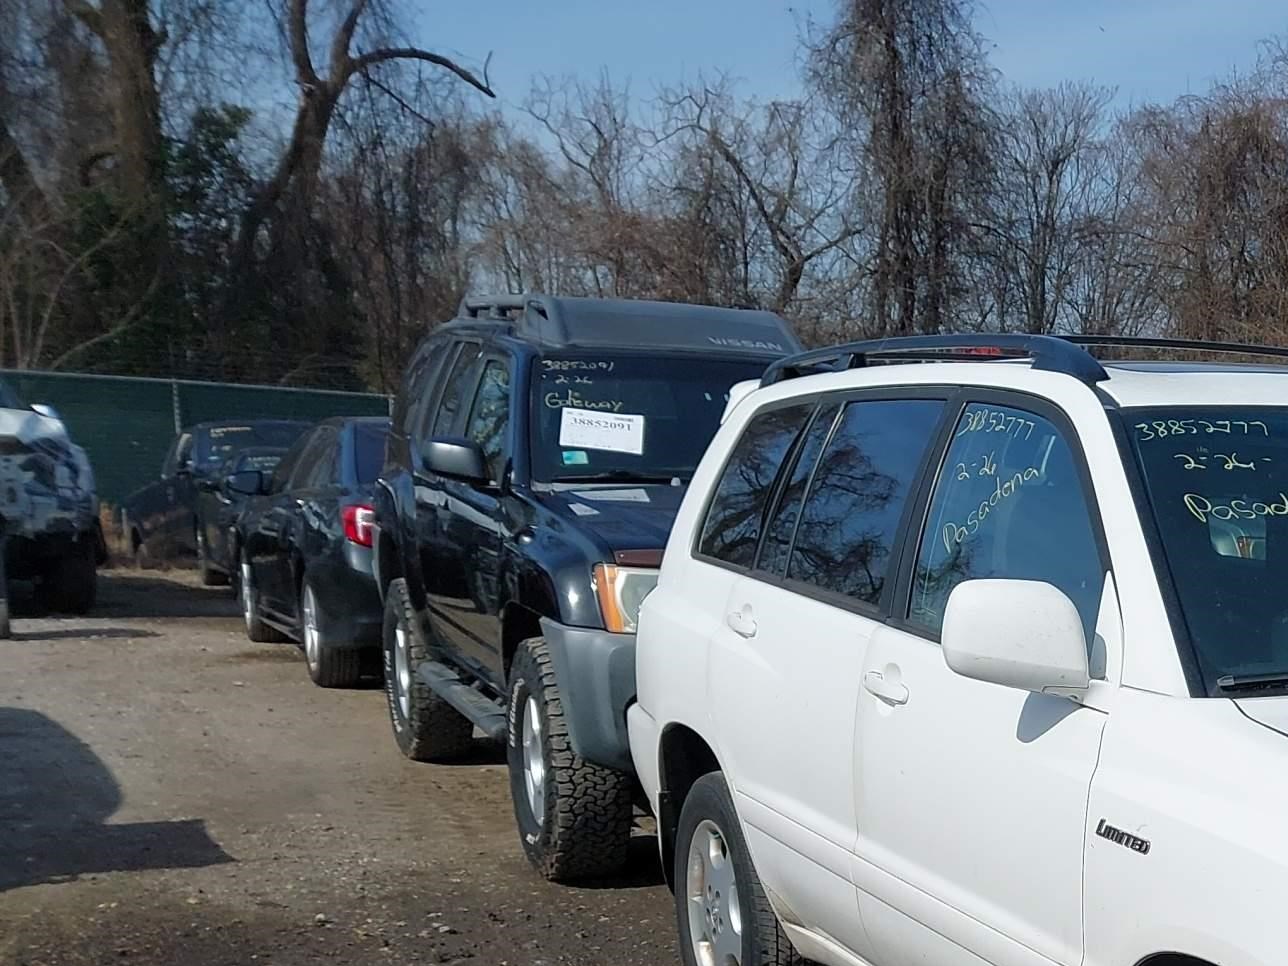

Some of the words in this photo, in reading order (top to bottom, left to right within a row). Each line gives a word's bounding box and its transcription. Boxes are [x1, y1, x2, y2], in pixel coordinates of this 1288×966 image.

[707, 336, 783, 352] NISSAN
[570, 416, 632, 432] 38852091
[956, 408, 1036, 441] 38852777
[1134, 419, 1269, 441] 38852777
[942, 466, 1040, 554] Pasadena
[1095, 818, 1151, 855] LIMITED
